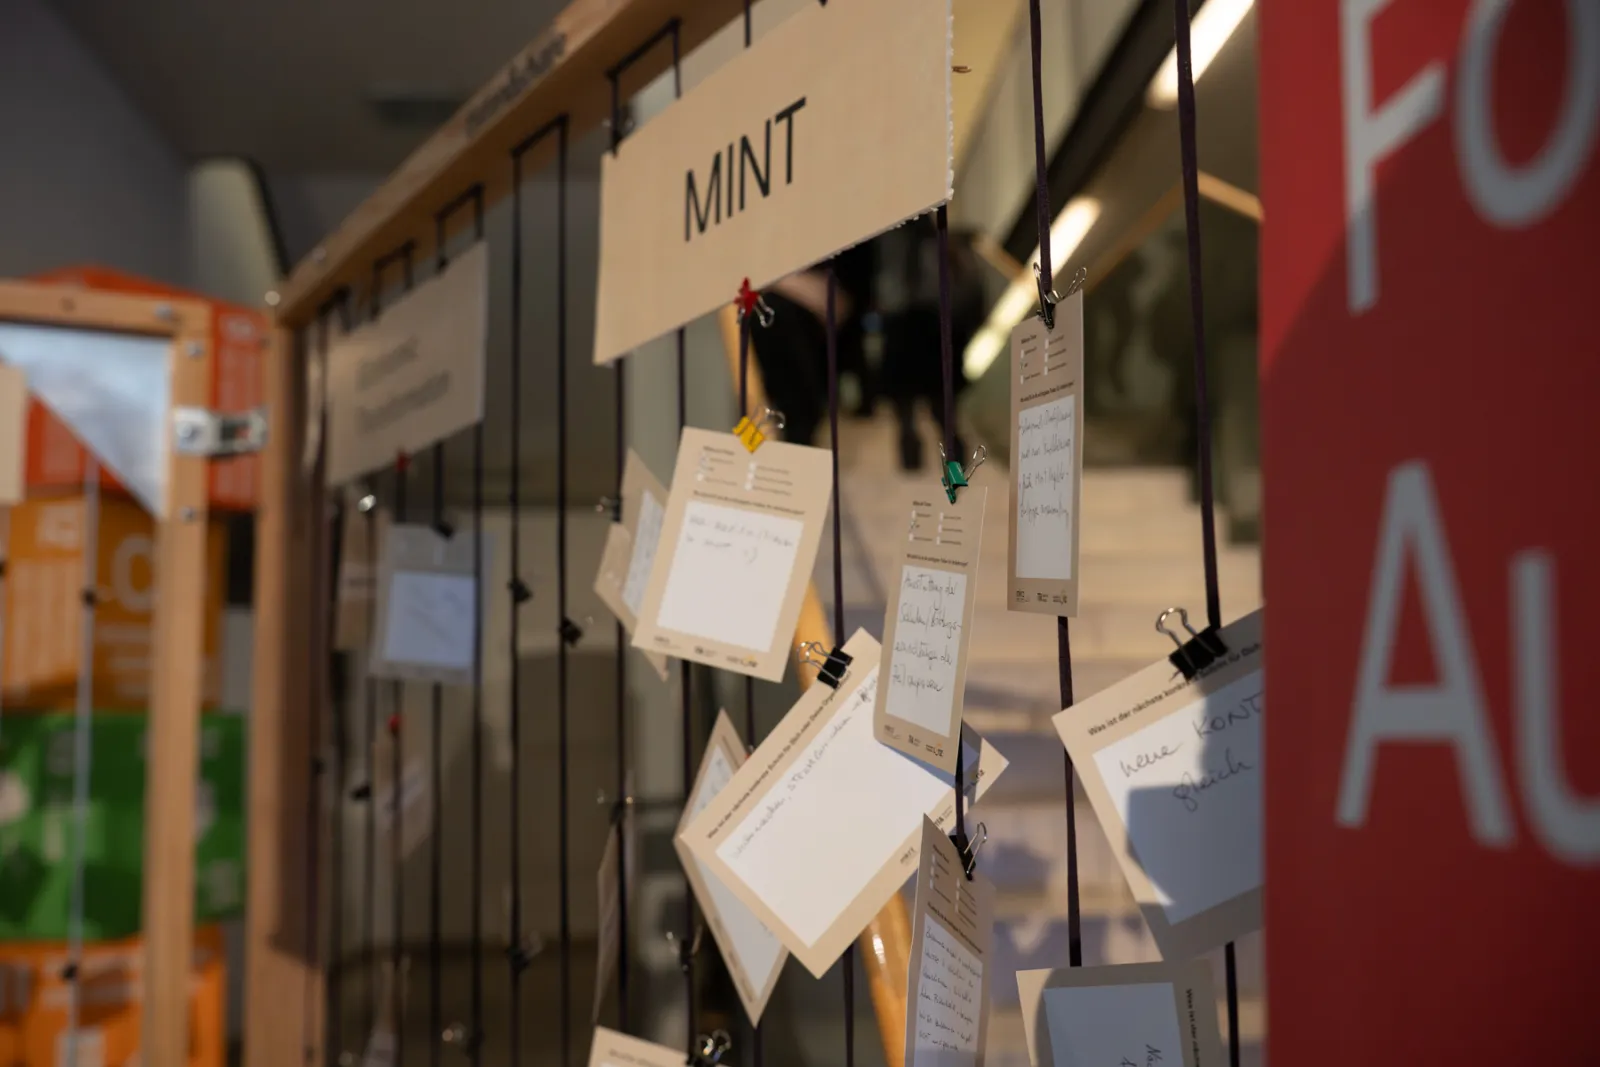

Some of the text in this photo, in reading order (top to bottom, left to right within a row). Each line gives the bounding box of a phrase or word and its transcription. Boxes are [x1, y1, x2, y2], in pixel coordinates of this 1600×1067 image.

[684, 96, 808, 243] MINT
[1088, 722, 1105, 734] Was
[1105, 716, 1116, 725] ist
[1117, 709, 1130, 720] der
[1131, 692, 1163, 712] nächste
[1173, 748, 1252, 813] gleich
